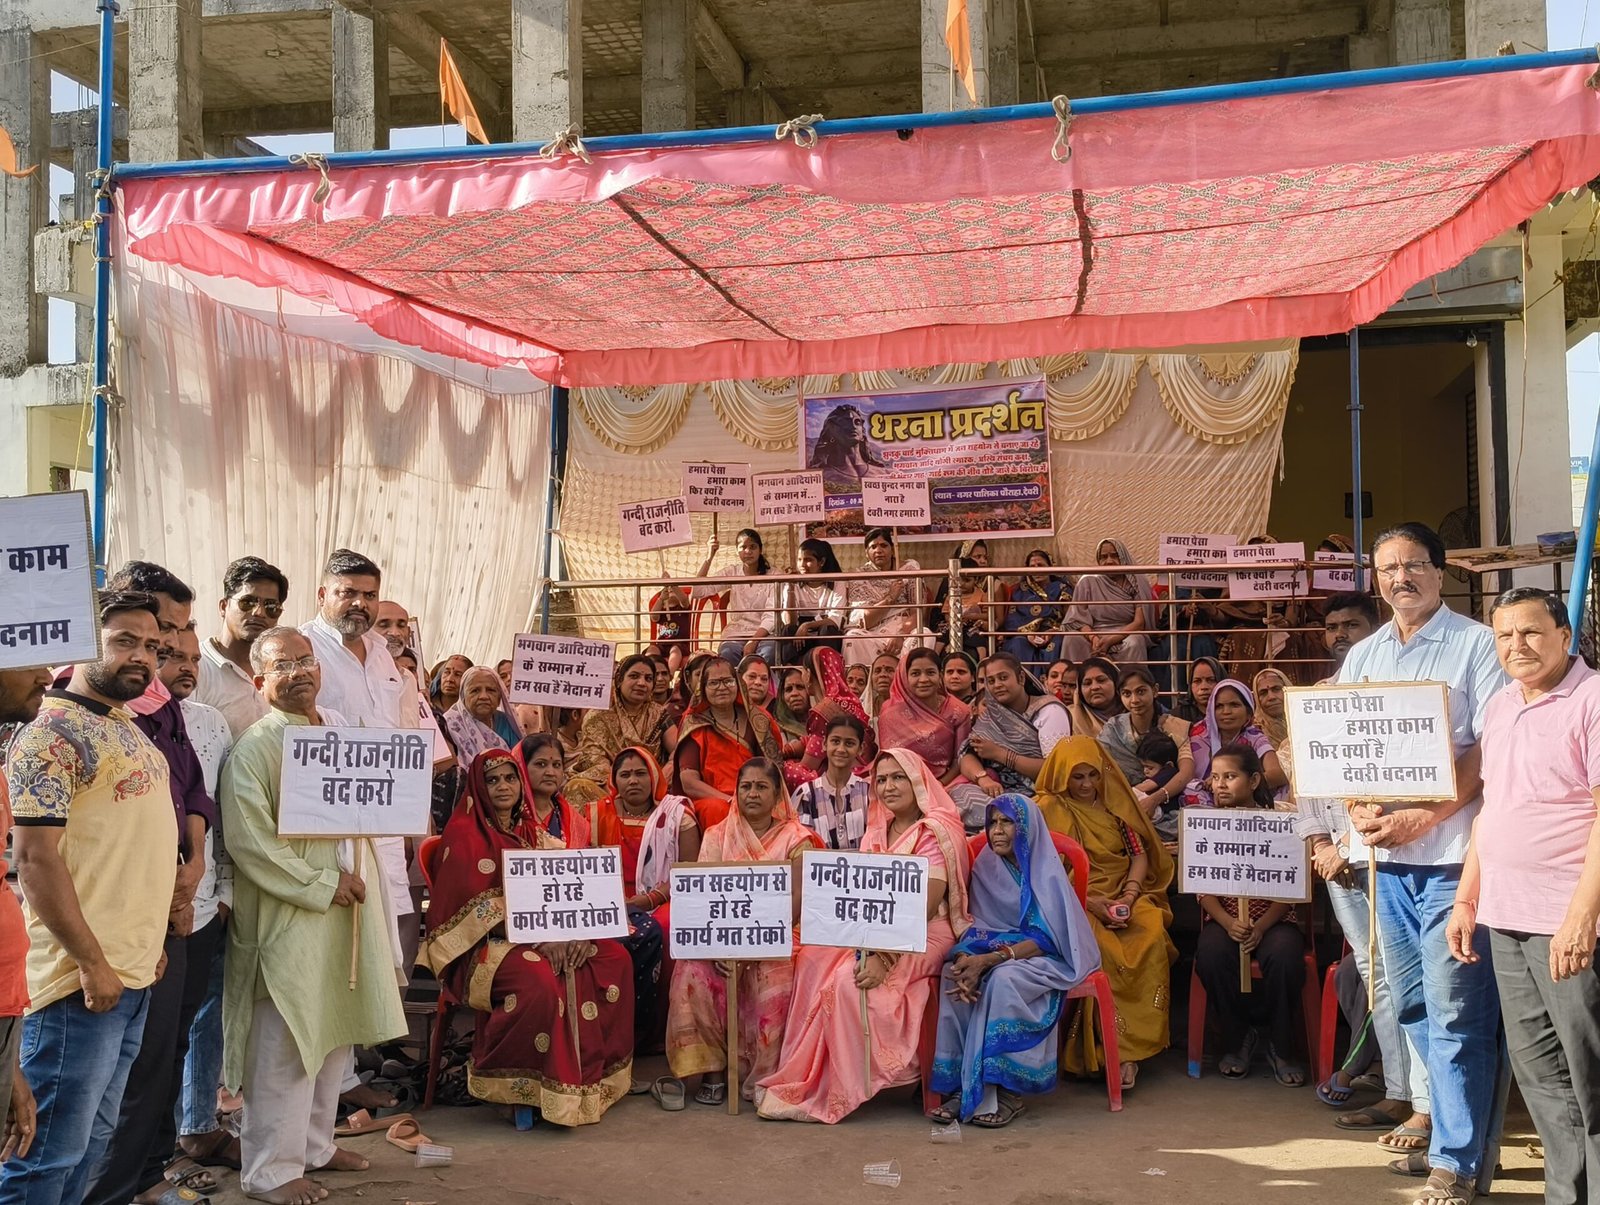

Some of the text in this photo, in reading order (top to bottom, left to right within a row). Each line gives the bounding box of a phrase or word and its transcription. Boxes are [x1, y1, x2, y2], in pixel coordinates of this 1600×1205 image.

[871, 391, 1044, 440] धरना प्रदर्शन
[688, 464, 726, 474] हमारा पैसा
[690, 486, 703, 495] फिर
[708, 476, 746, 486] हमारा काम
[758, 474, 821, 487] भगवान आदियोगी
[881, 482, 898, 492] सुन्दर
[764, 490, 771, 501] के
[774, 491, 798, 500] सम्मान
[885, 495, 899, 503] नारा
[974, 488, 998, 498] पालिका
[622, 499, 685, 520] गन्दी राजनीति
[760, 507, 771, 516] हम
[794, 504, 813, 513] मैदान
[884, 509, 898, 517] नगर
[900, 509, 918, 517] हमारा
[1166, 535, 1208, 546] हमारा पैसा
[7, 544, 70, 572] काम
[1187, 549, 1210, 558] हमारा
[1233, 546, 1275, 558] हमारा पैसा
[1254, 581, 1271, 590] देवरी
[0, 619, 71, 648] दनाम
[518, 639, 610, 658] भगवान आदियोगी
[523, 657, 598, 677] के सम्मान में...
[514, 680, 532, 691] हम
[533, 682, 551, 693] सब
[563, 680, 592, 697] मैदान
[594, 684, 605, 698] में
[1302, 691, 1384, 714] हमारा पैसा
[1345, 717, 1434, 735] हमारा काम
[293, 731, 428, 770] गन्दी राजनीति
[1309, 738, 1385, 760] फिर क्यों है
[1342, 762, 1437, 782] देवरी बदनाम
[322, 768, 395, 806] बंद करो
[1188, 816, 1297, 834] भगवान आदियोग
[1195, 838, 1288, 858] के सम्मान में...
[509, 850, 616, 876] जन सहयोग से
[675, 867, 787, 892] जन सहयोग से
[811, 857, 923, 893] गन्दी राजनीति
[1188, 865, 1208, 879] हम
[1210, 866, 1231, 880] सब
[1245, 864, 1282, 883] मैदान
[1284, 866, 1298, 884] में
[542, 877, 584, 902] हो रहे
[512, 901, 619, 930] कार्य मत रोको
[709, 894, 753, 919] हो रहे
[835, 889, 896, 925] बंद करो
[675, 920, 786, 946] कार्य मत रोको
